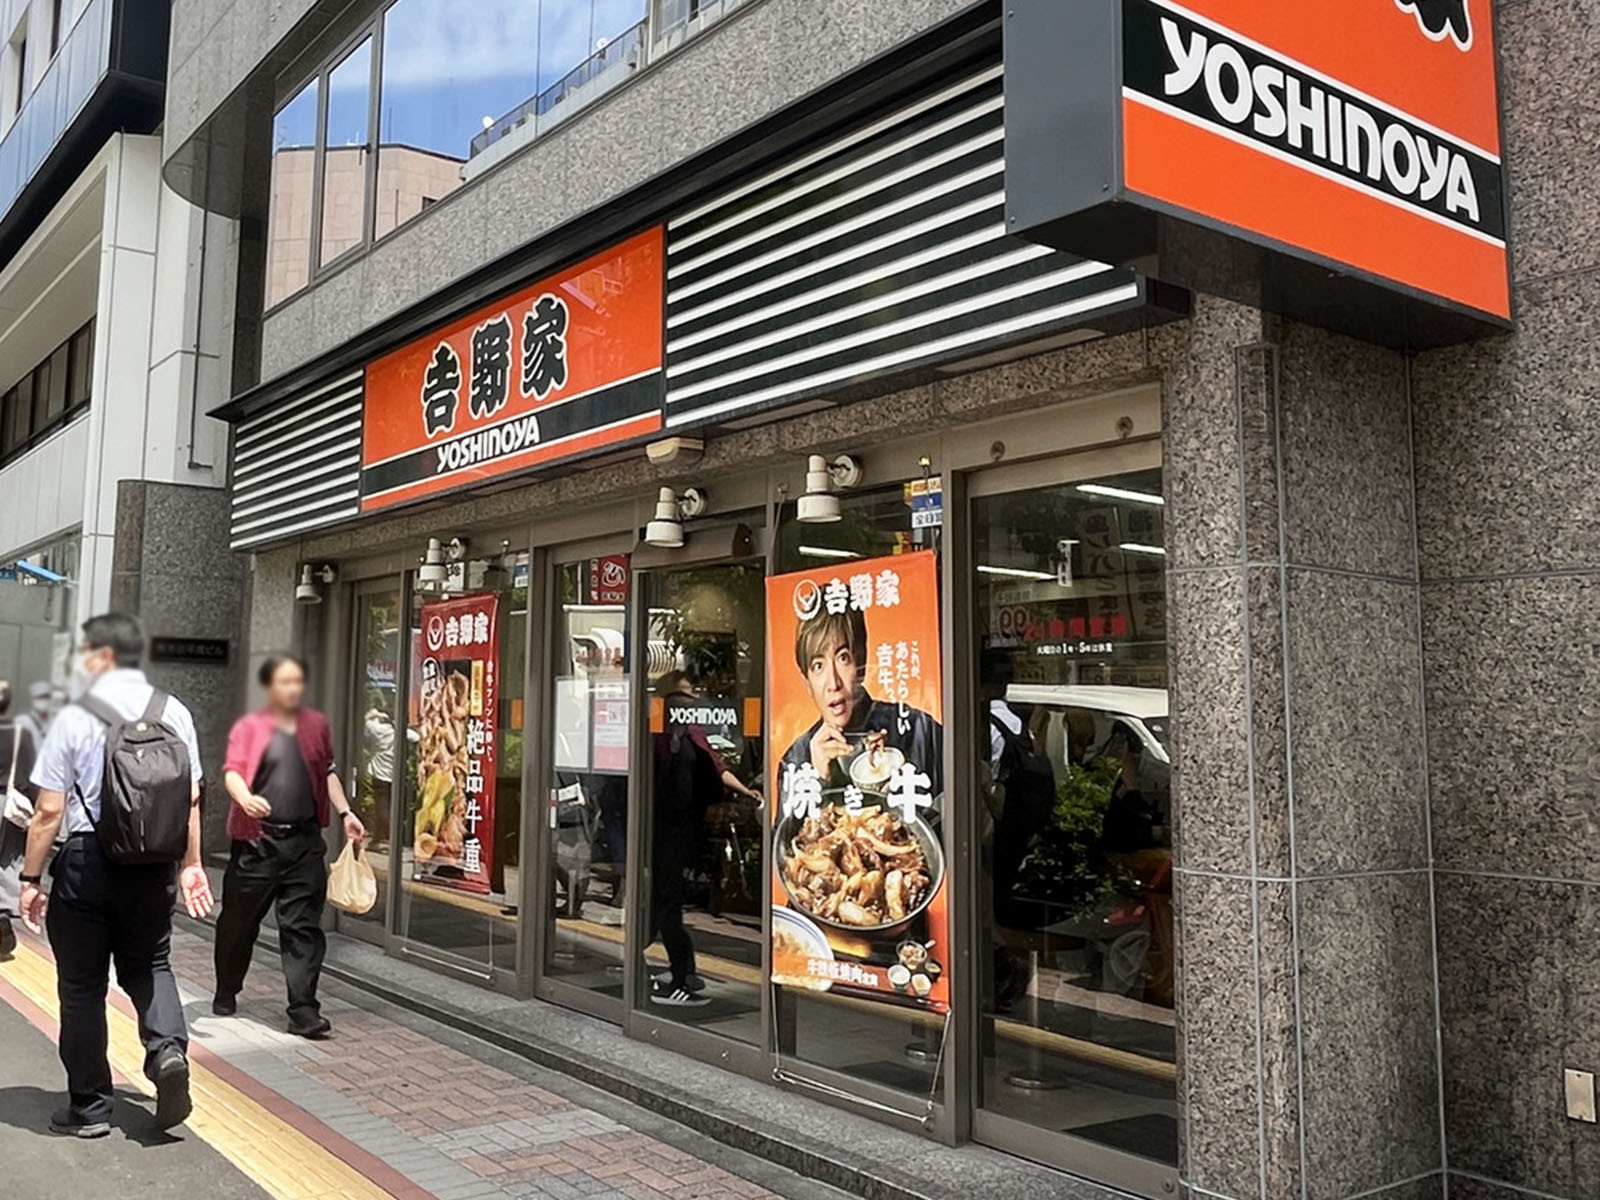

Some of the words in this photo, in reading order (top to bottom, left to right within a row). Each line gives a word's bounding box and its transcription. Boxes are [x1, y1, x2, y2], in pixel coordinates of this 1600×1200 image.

[1160, 17, 1480, 222] YOSHINOYA
[421, 293, 569, 438] 吉野家
[436, 416, 540, 473] YOSHINOYA
[445, 611, 489, 648] 吉野家
[824, 569, 900, 615] 吉野家
[669, 707, 737, 726] YOSHINOYA
[895, 641, 911, 735] あたらしい
[465, 718, 485, 873] 絶品牛重
